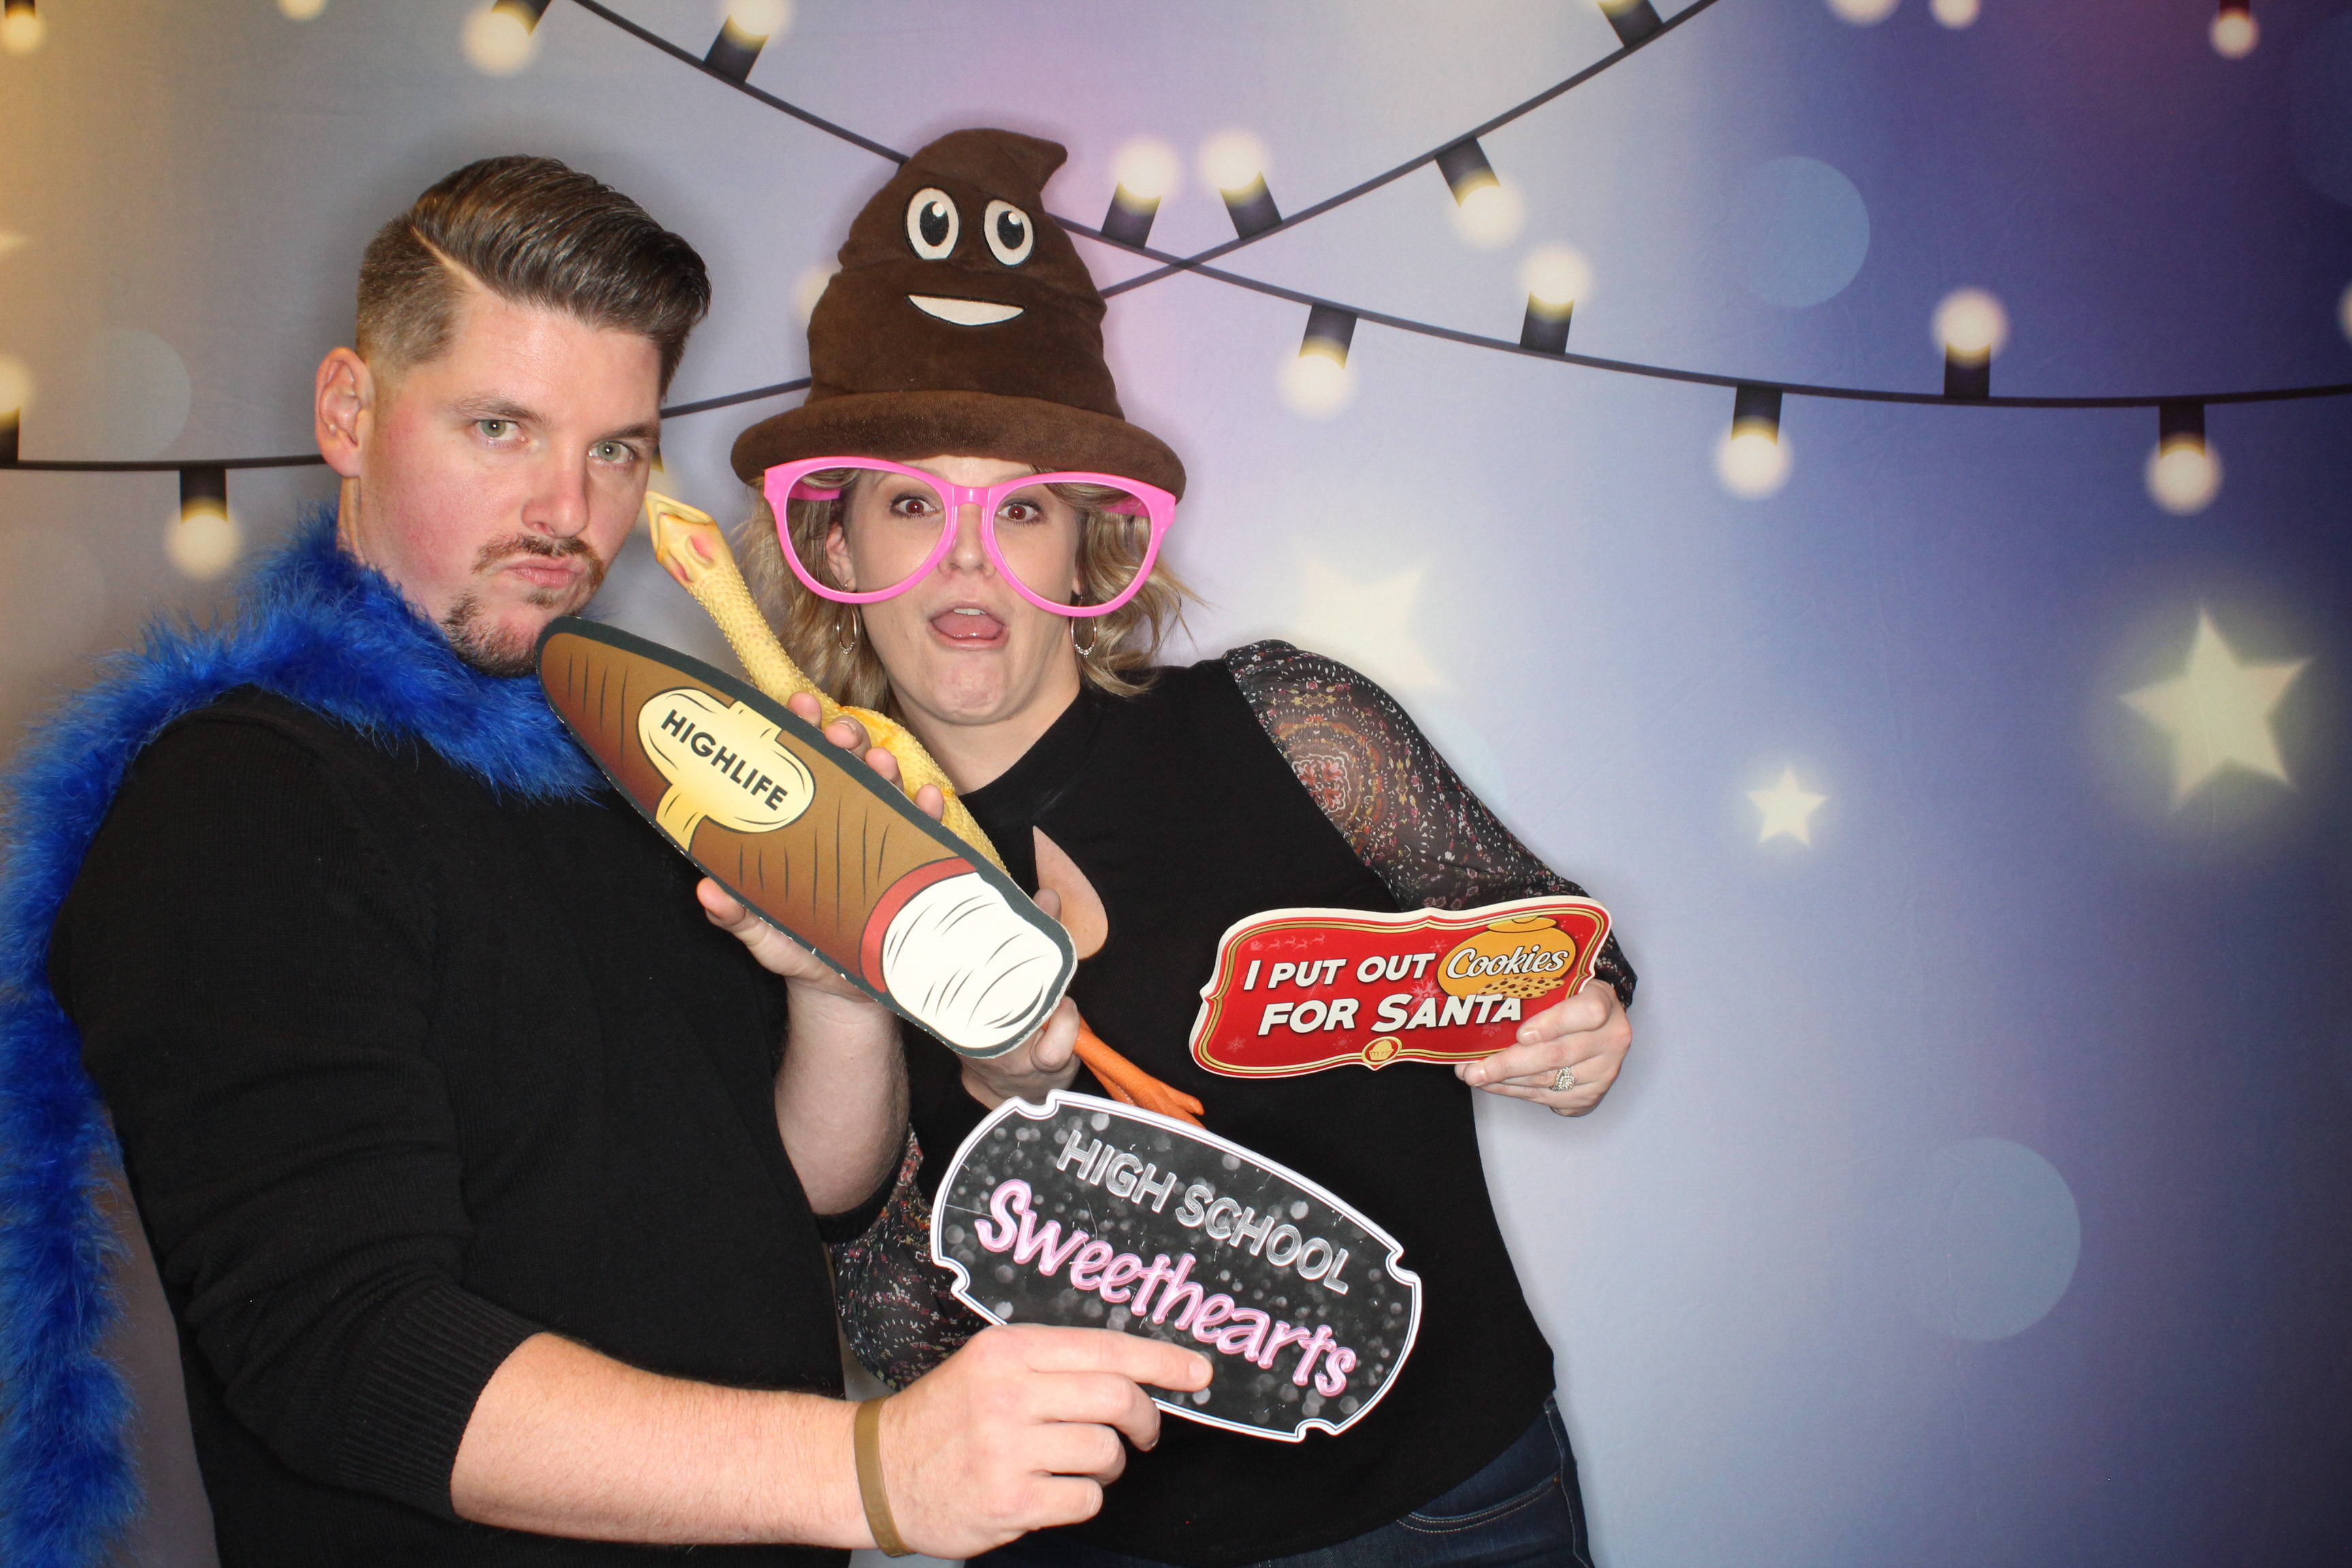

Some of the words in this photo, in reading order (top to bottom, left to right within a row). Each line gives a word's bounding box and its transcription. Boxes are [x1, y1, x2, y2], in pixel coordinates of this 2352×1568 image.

[661, 710, 787, 811] HIGHLIFE
[1243, 960, 1261, 990] I
[1267, 959, 1346, 989] PUT
[1356, 953, 1436, 983] OUT
[1447, 945, 1569, 980] Cookies
[1258, 998, 1359, 1036] FOR
[1371, 994, 1521, 1032] SANTA
[1056, 1130, 1177, 1213] HIGH
[1176, 1184, 1350, 1294] SCHOOL
[974, 1179, 1356, 1396] Sweethearts
